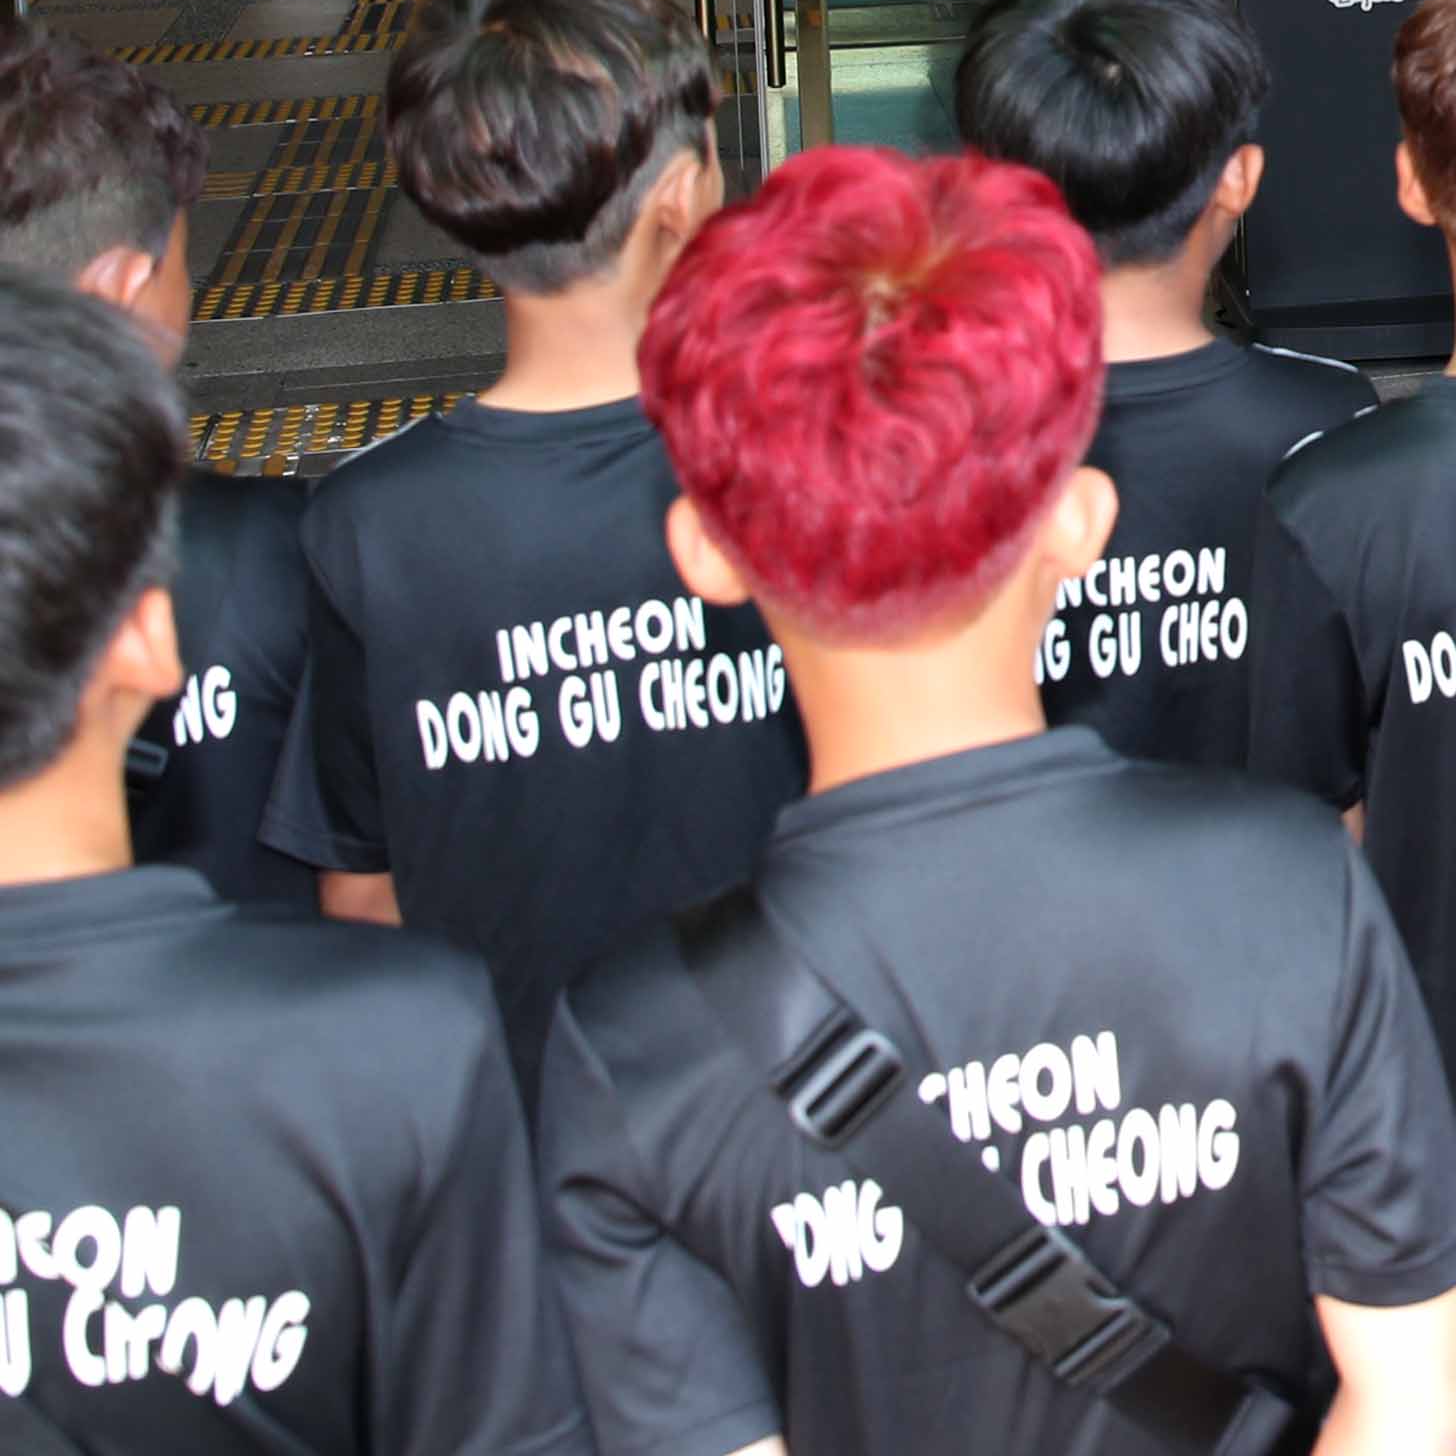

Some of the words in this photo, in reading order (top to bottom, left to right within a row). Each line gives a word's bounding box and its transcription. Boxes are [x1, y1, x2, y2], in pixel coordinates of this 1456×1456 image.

[496, 597, 706, 683] INCHEON
[1088, 611, 1141, 678] GU
[416, 685, 540, 770] DONG
[558, 672, 621, 747] GU
[639, 643, 786, 731] CHEONG
[1021, 1099, 1240, 1226] CHEONG
